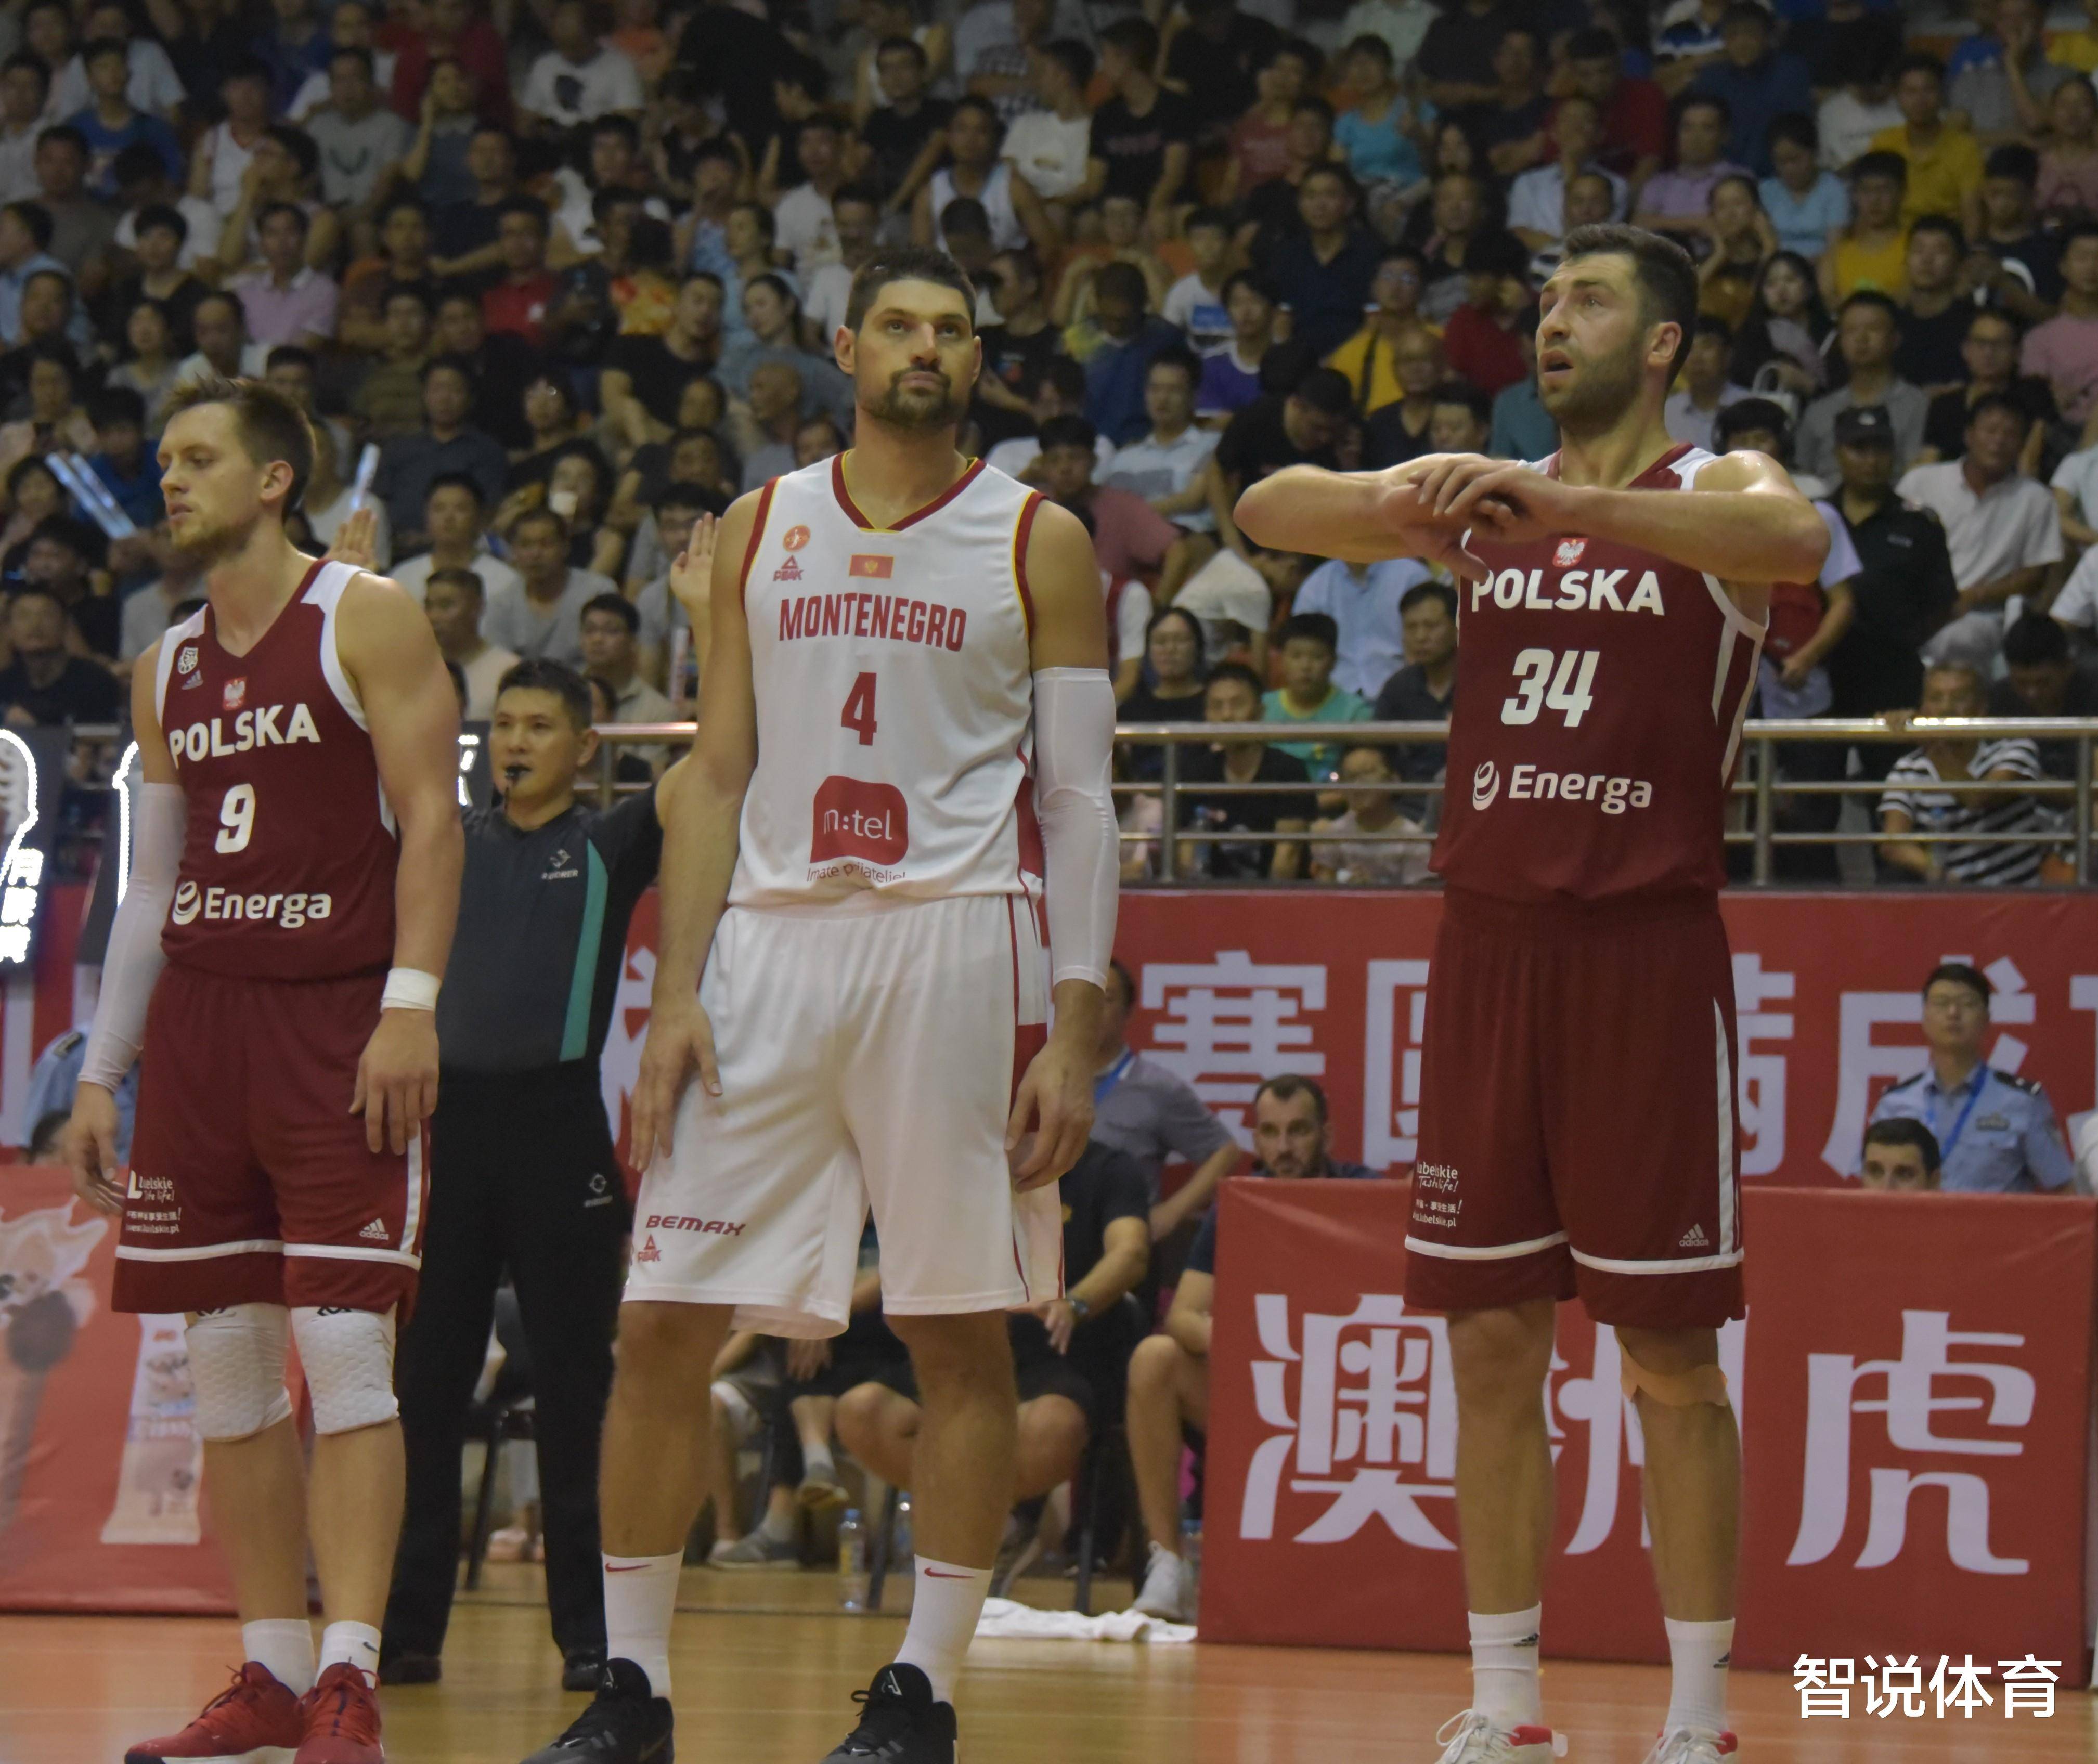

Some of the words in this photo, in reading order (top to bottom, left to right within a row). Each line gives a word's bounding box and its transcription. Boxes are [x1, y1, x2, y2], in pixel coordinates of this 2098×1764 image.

[1472, 568, 1665, 616] POLSKA
[779, 592, 967, 652] MONTENEGRO
[840, 671, 877, 746] 4
[1500, 648, 1600, 728] 34
[169, 703, 321, 770] POLSKA
[1508, 764, 1652, 815] Energa
[215, 783, 256, 854] 9
[824, 809, 893, 840] m:tel
[807, 865, 839, 882] Imate
[205, 887, 332, 929] Energa
[359, 1230, 390, 1241] adidas
[645, 1215, 746, 1236] BEMAX
[1678, 1238, 1710, 1247] adidas
